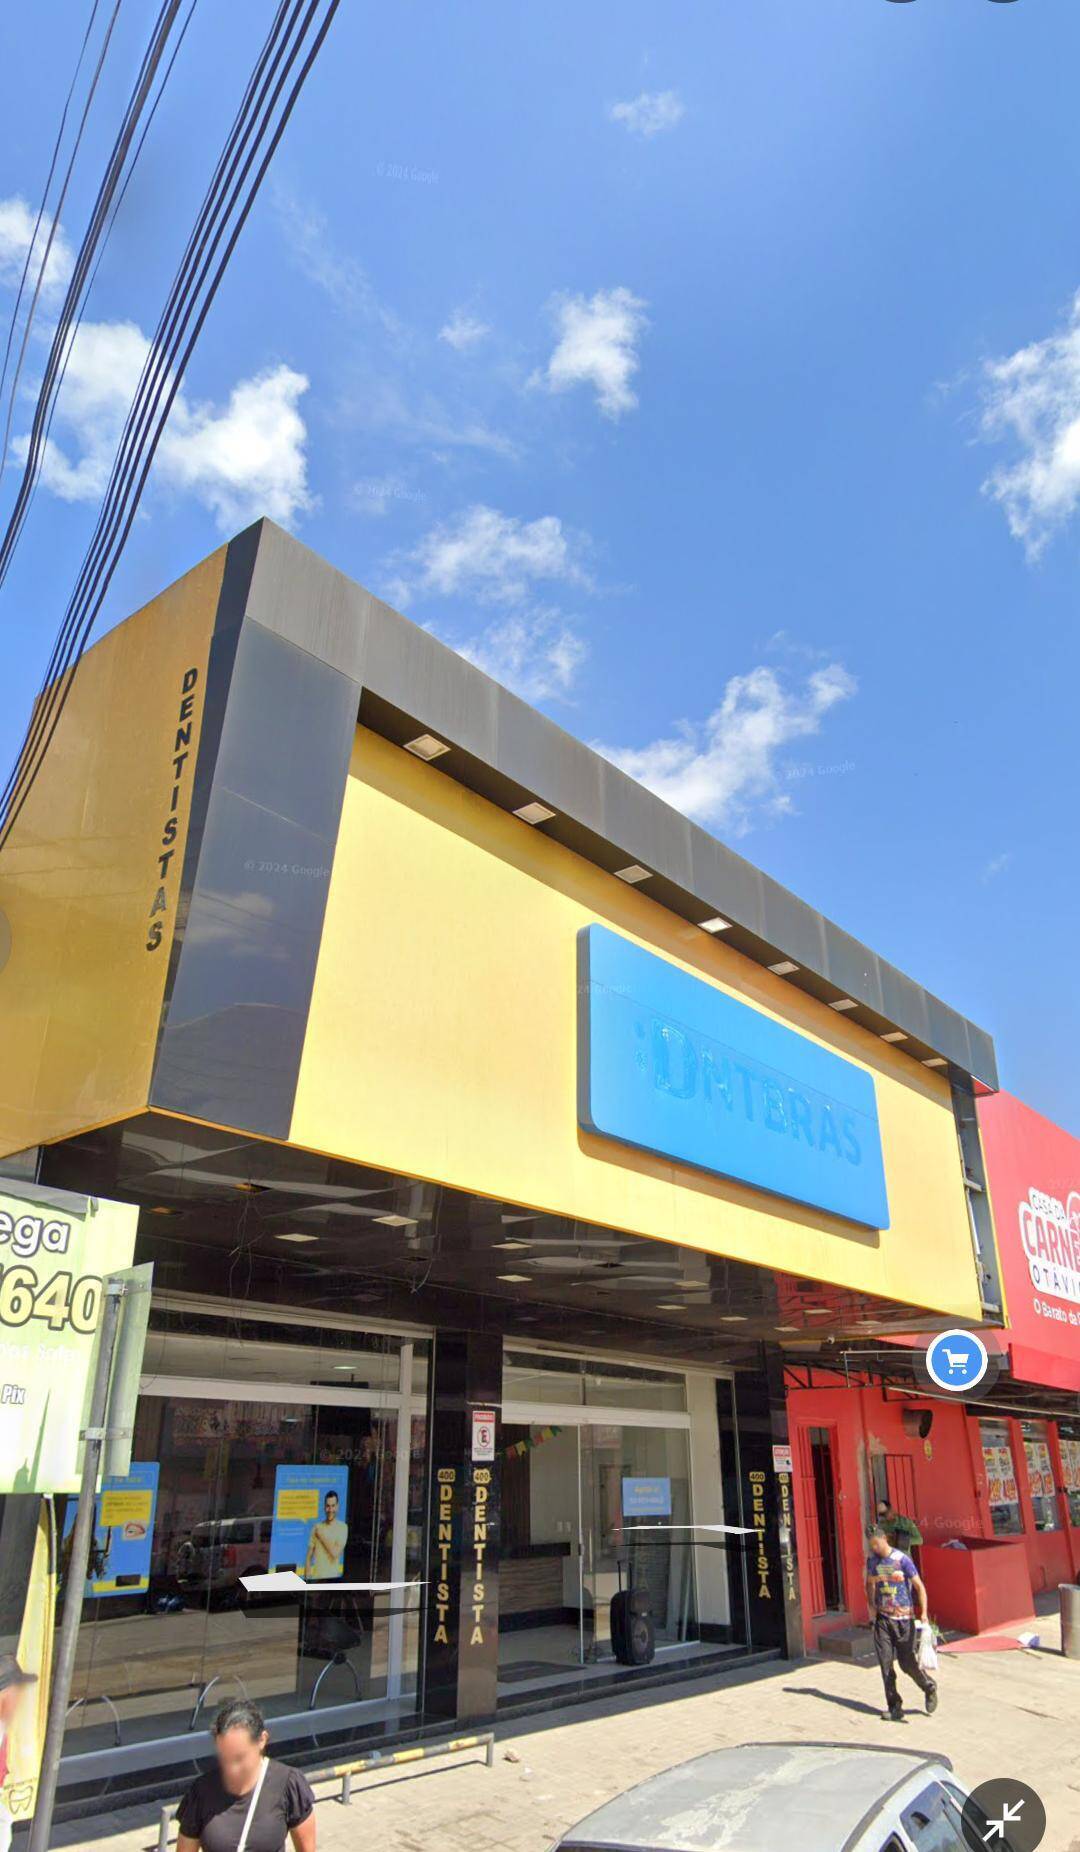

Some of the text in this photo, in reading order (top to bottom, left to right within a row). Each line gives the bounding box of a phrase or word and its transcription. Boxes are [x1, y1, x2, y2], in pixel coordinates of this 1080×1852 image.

[145, 667, 198, 952] DENTISTAS
[1032, 1264, 1080, 1298] OTÁVI
[1, 1384, 26, 1404] Pix
[438, 1470, 455, 1482] 400
[474, 1471, 489, 1482] 400
[434, 1484, 453, 1645] DENTISTA
[470, 1485, 488, 1645] DENTISTA
[752, 1484, 772, 1599] DENTISTA
[780, 1484, 797, 1600] DENTISTA
